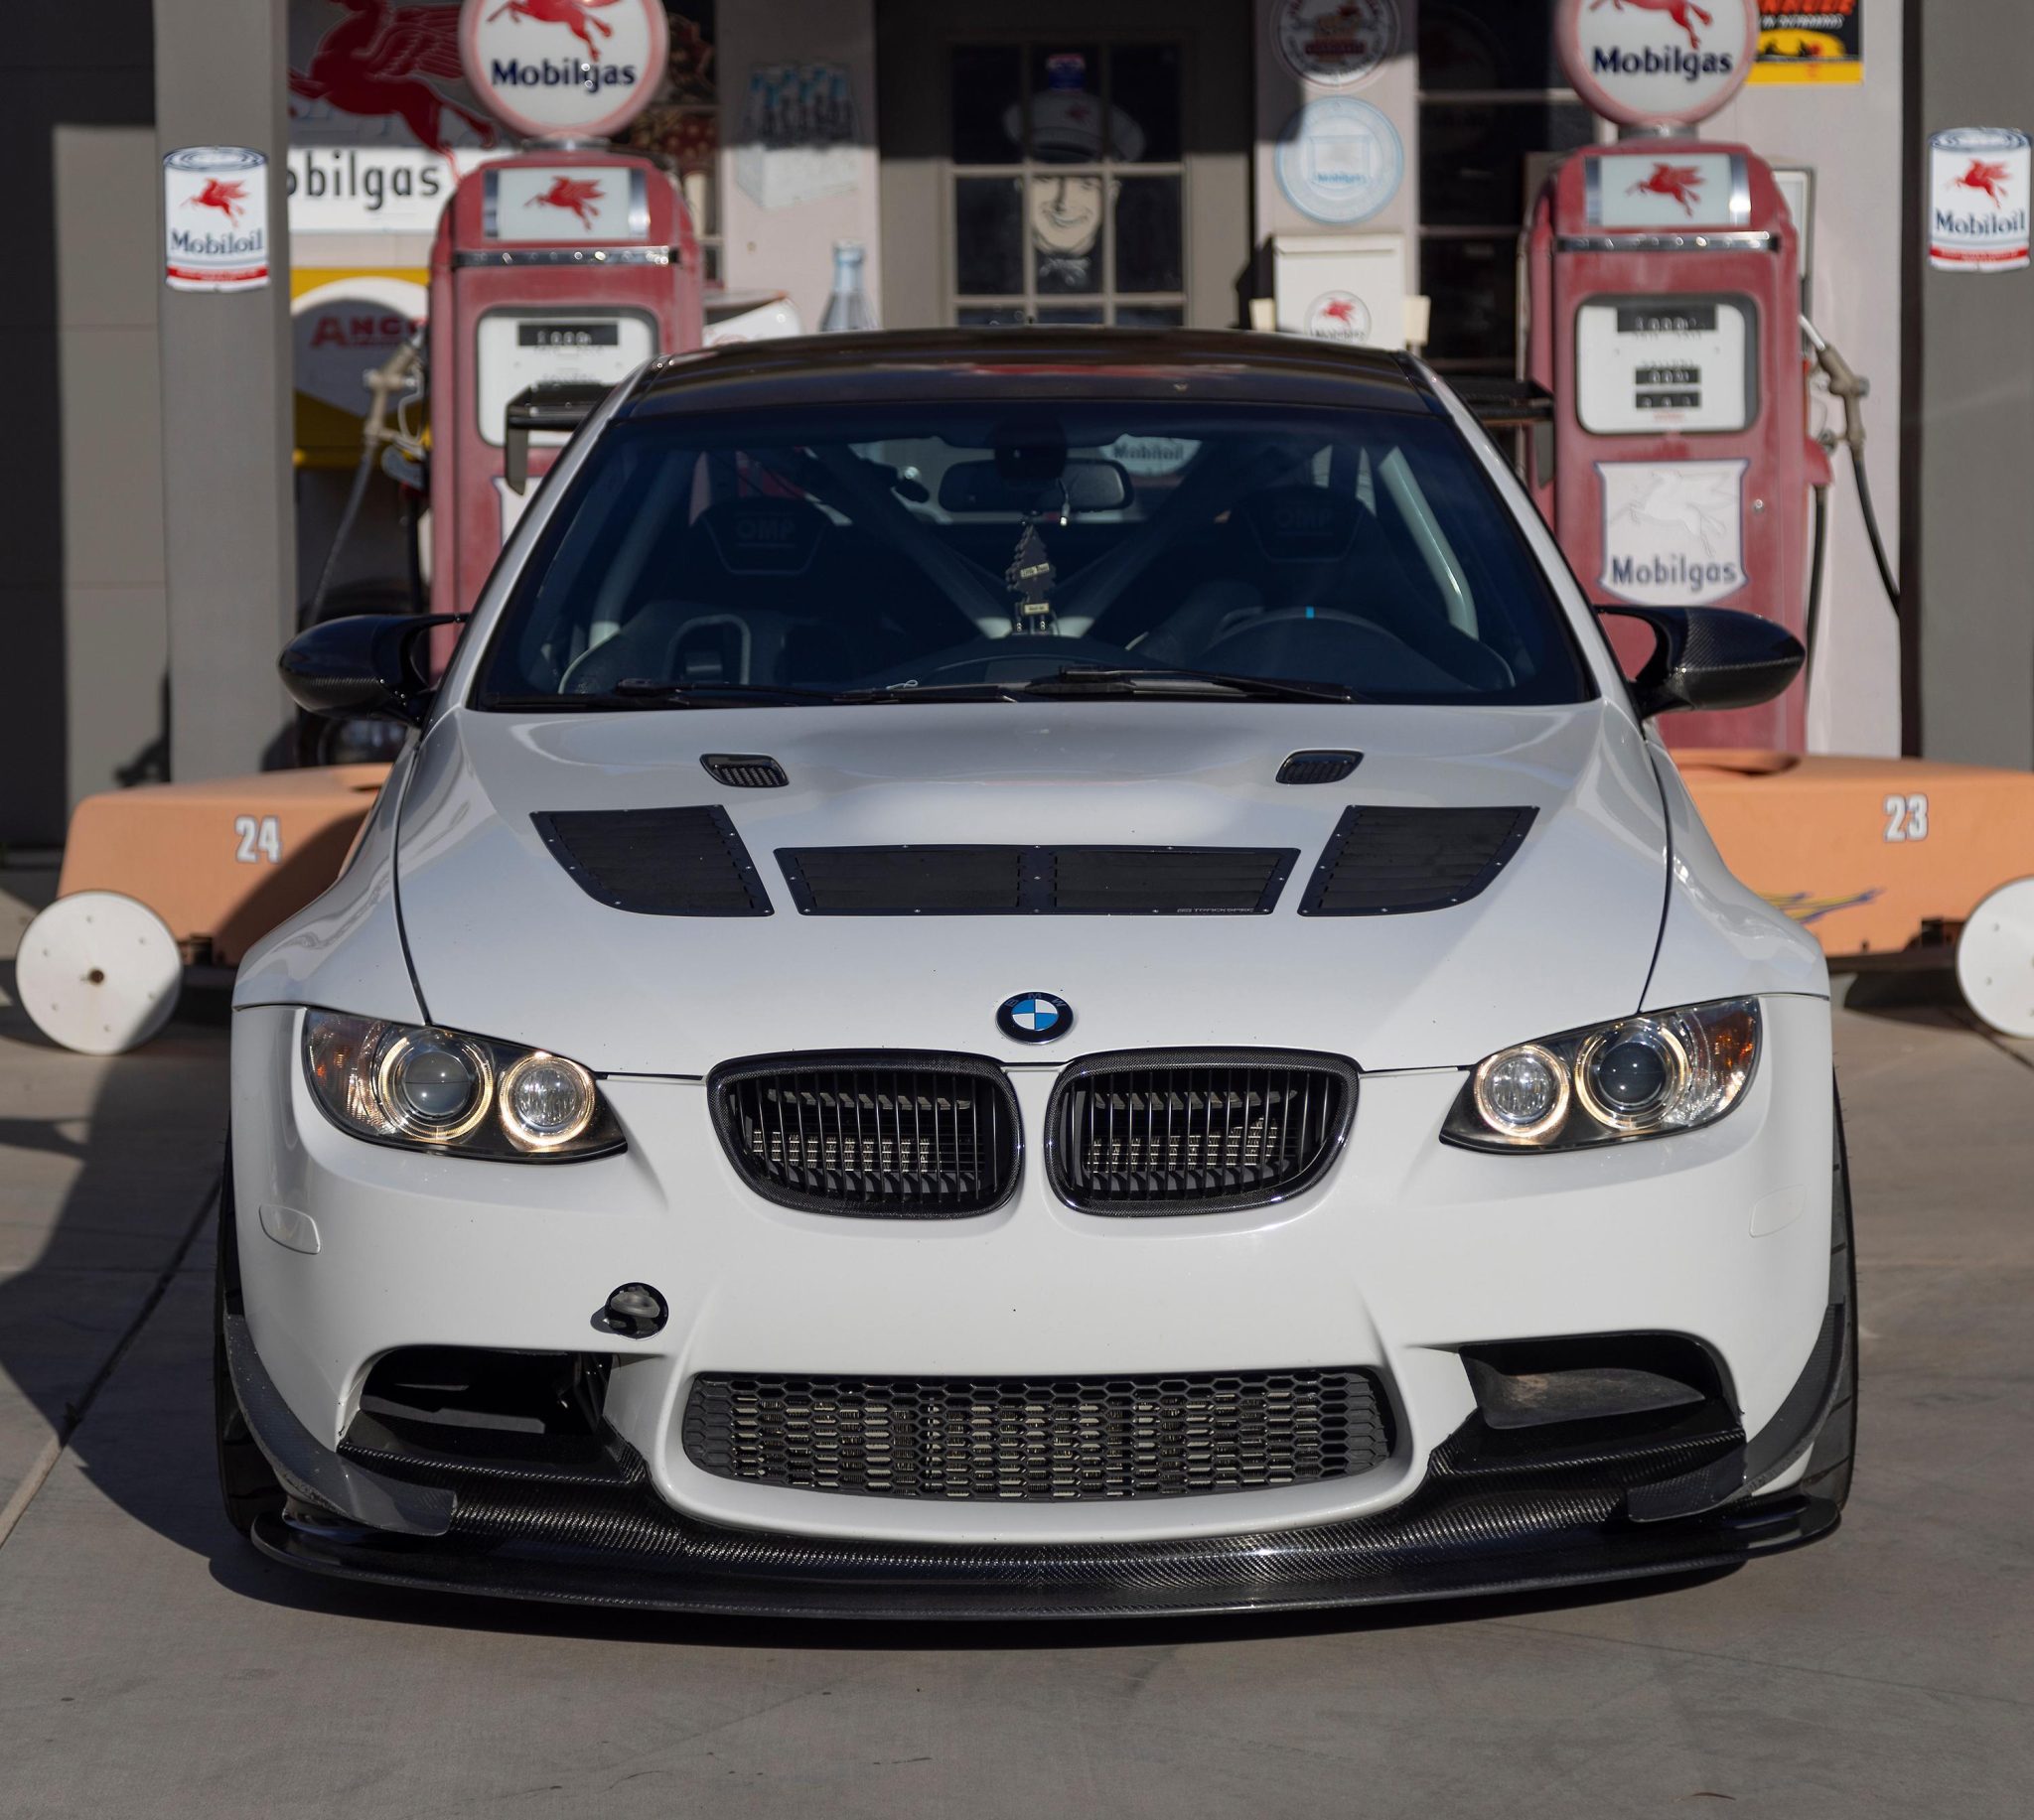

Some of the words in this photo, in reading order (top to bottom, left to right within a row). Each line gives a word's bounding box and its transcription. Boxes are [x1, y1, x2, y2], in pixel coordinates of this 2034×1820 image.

[492, 58, 637, 94] Mobilgas
[1591, 45, 1733, 80] Mobilgas
[1936, 207, 2026, 235] Mobiloil
[170, 228, 263, 255] Mobiloil
[735, 518, 796, 540] OMP
[1612, 554, 1737, 593] Mobilgas
[1883, 793, 1929, 842] 23
[233, 814, 282, 864] 24
[1003, 993, 1068, 1008] BMW
